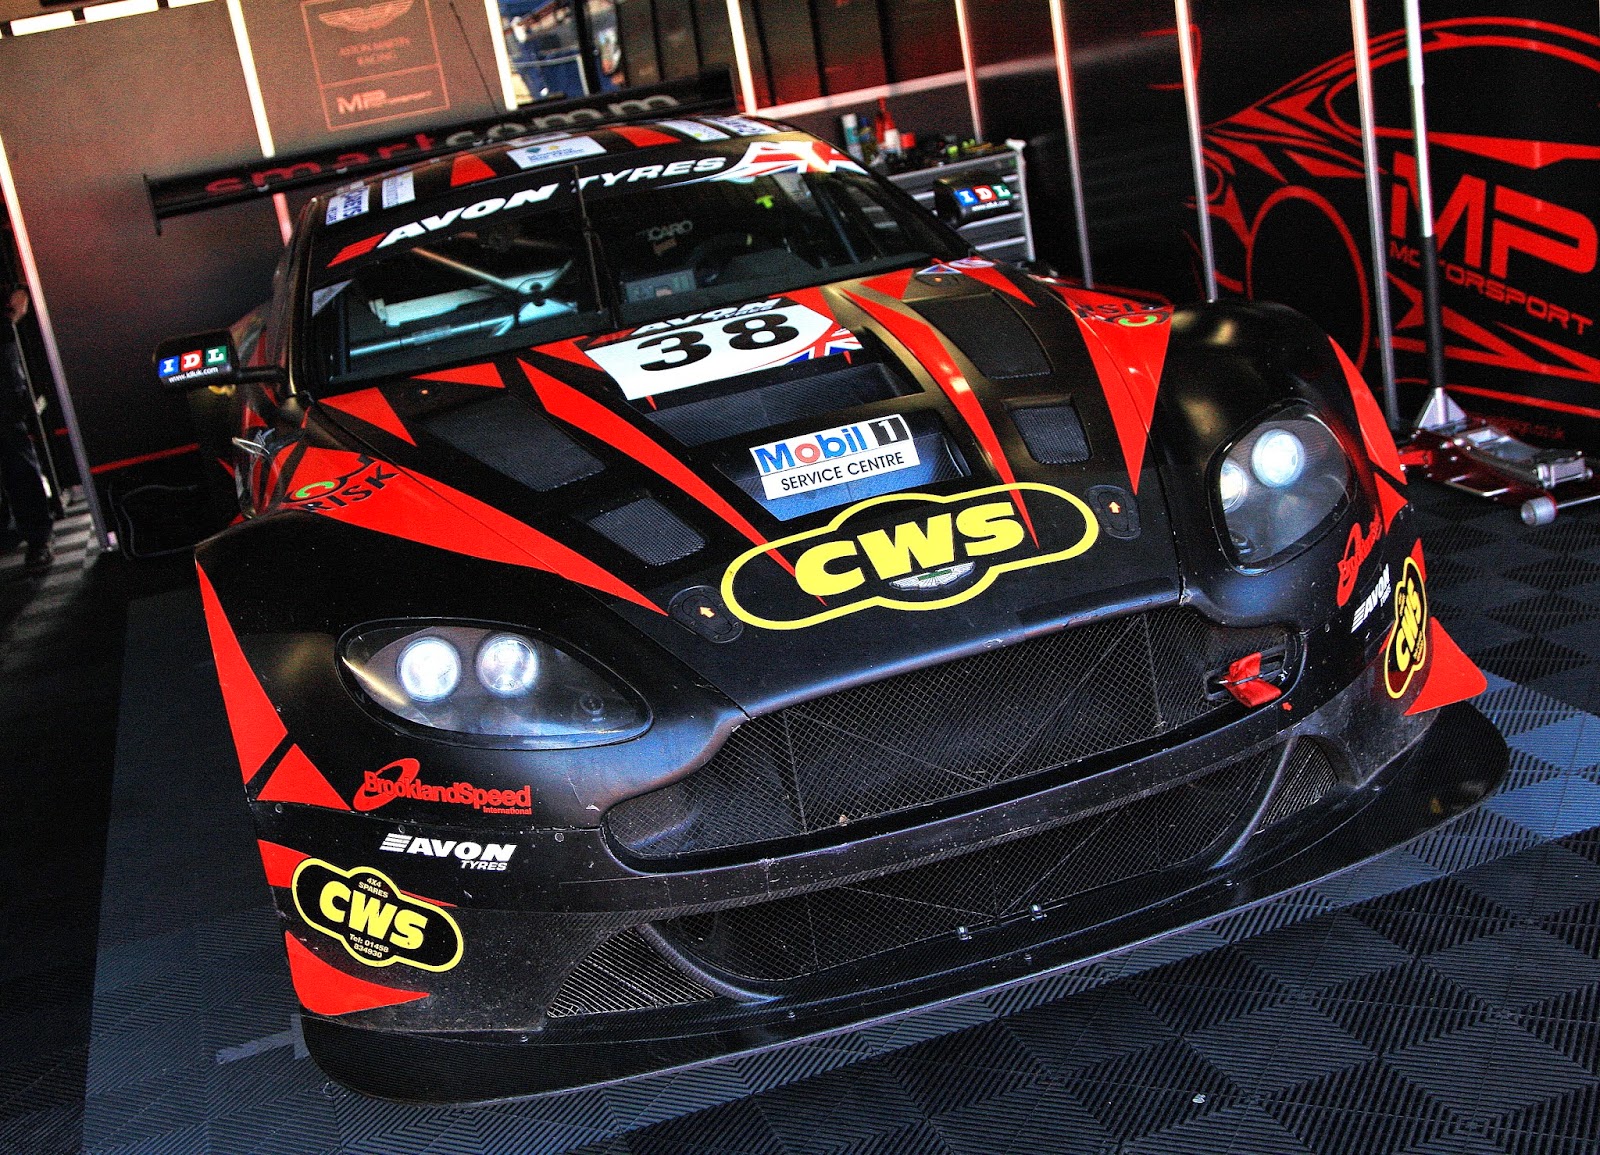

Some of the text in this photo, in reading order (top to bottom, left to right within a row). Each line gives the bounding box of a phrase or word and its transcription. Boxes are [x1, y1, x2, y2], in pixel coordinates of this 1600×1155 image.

[377, 182, 560, 249] AVON
[569, 157, 727, 193] TYRES
[959, 185, 1011, 204] IDL
[1388, 151, 1598, 279] MP
[1389, 240, 1594, 336] MOORSPORT
[631, 298, 783, 336] AVON
[163, 348, 225, 374] IDL
[637, 314, 800, 371] 38
[754, 420, 899, 474] Mobil 1
[781, 452, 904, 491] SERVICE CENTRE
[795, 502, 1025, 596] CWS
[1362, 563, 1391, 619] AVON
[1396, 577, 1422, 672] CWS
[364, 770, 532, 810] BrooklandSpeed
[483, 805, 533, 816] International
[406, 836, 518, 863] AVON
[461, 860, 508, 872] TYRES
[358, 881, 389, 899] SPARES
[366, 877, 382, 888] 4X4
[319, 880, 429, 950] CWS
[349, 933, 389, 954] Tel: 01458
[353, 943, 383, 959] 834930
